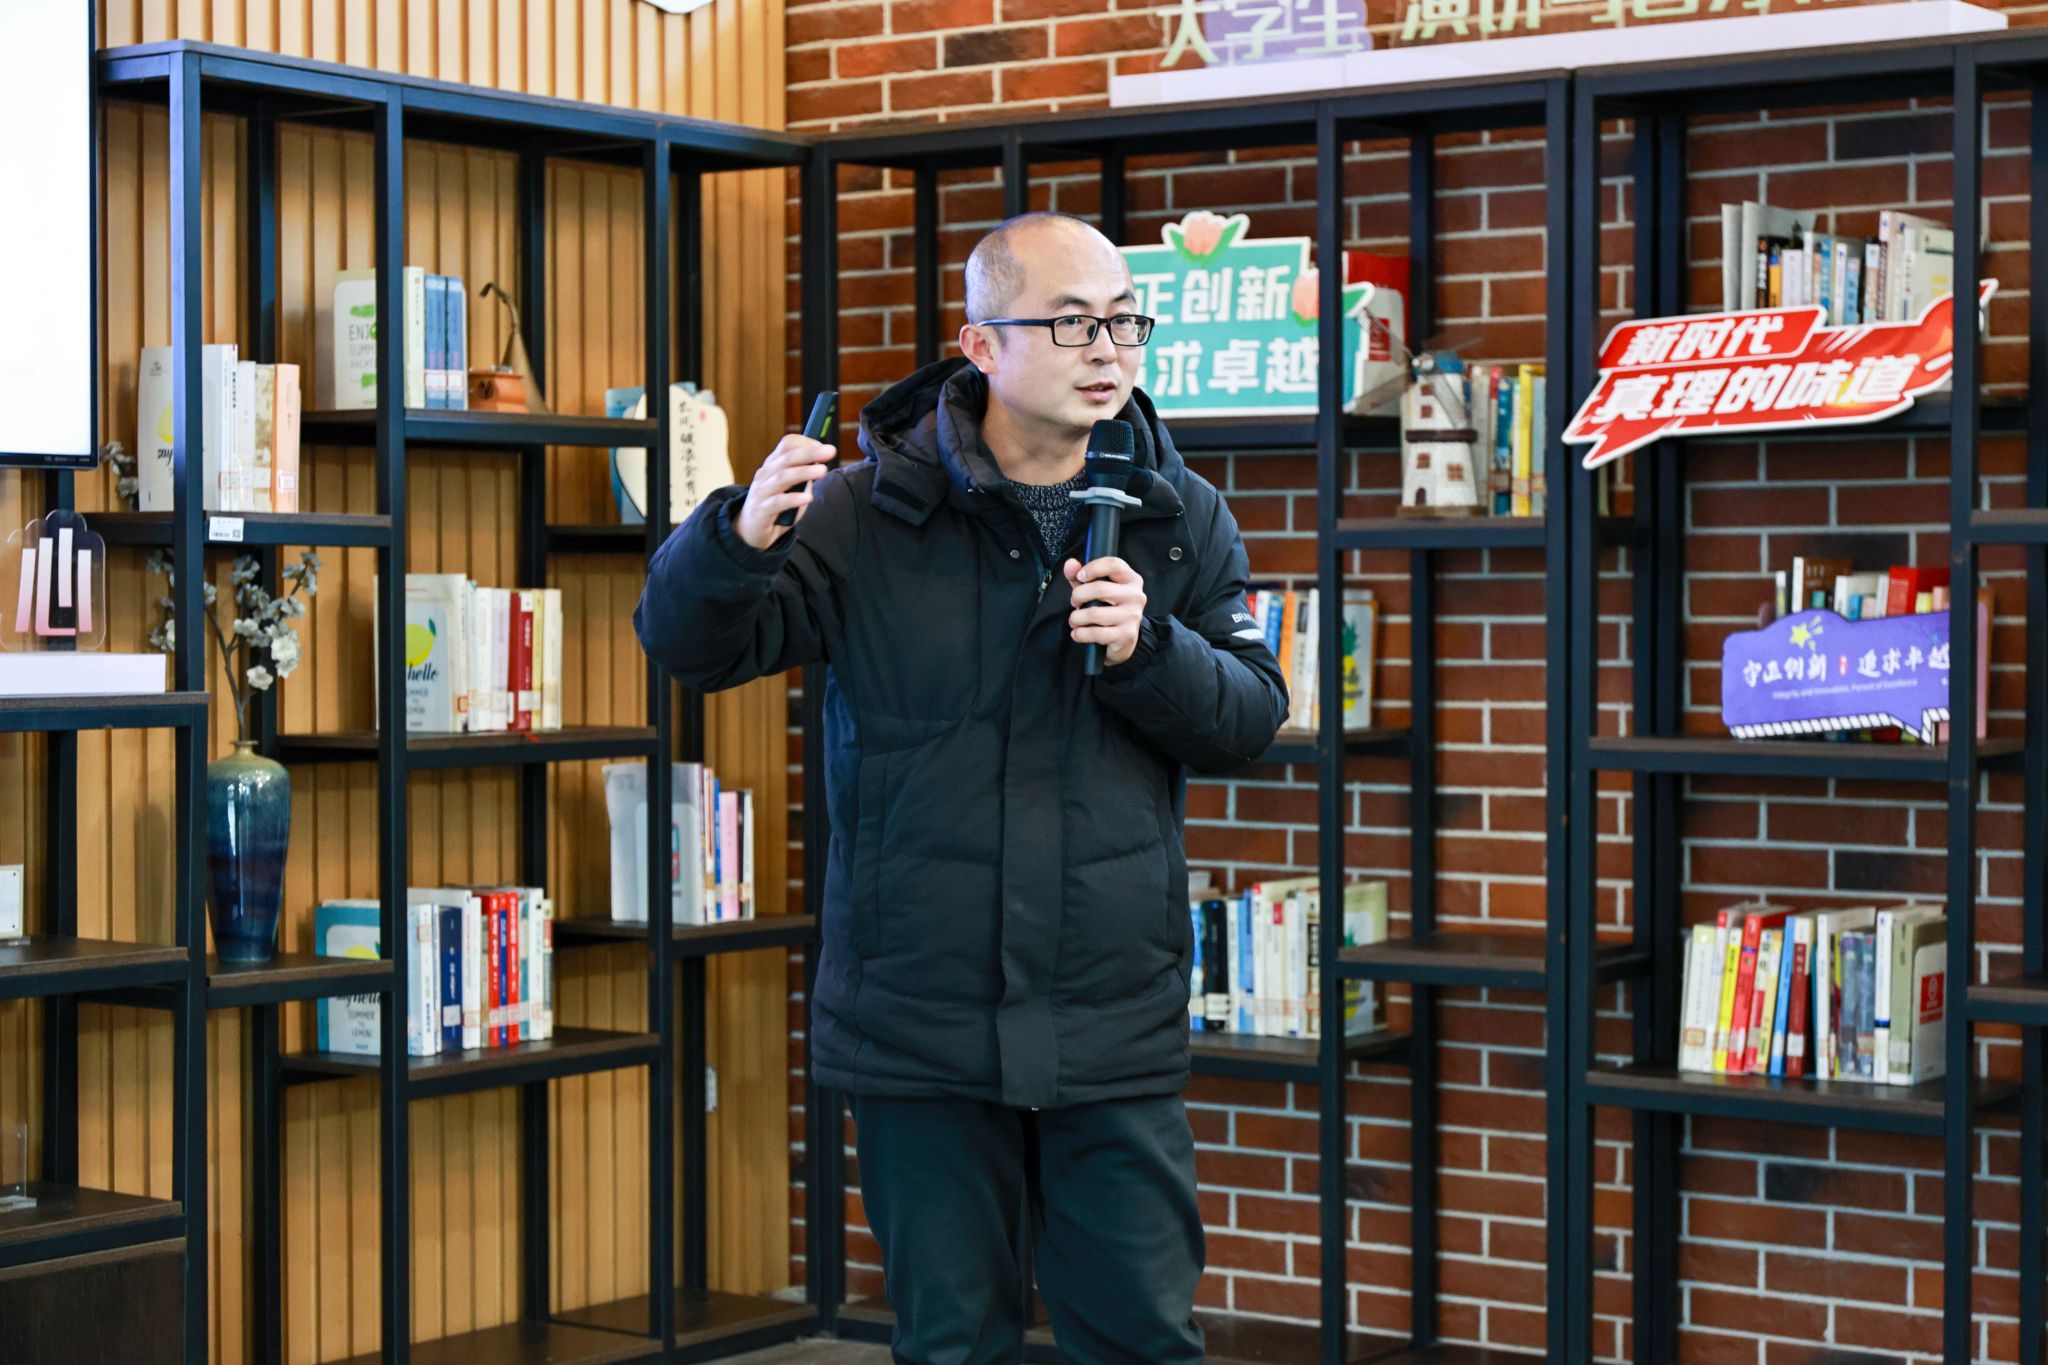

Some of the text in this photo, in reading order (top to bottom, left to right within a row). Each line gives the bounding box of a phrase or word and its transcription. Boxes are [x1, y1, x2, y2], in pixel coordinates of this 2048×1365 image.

[1134, 337, 1319, 397] 求卓越
[1618, 315, 1784, 367] 新时代
[1592, 354, 1920, 423] 真理的味道
[1743, 654, 1827, 688] 守正创新
